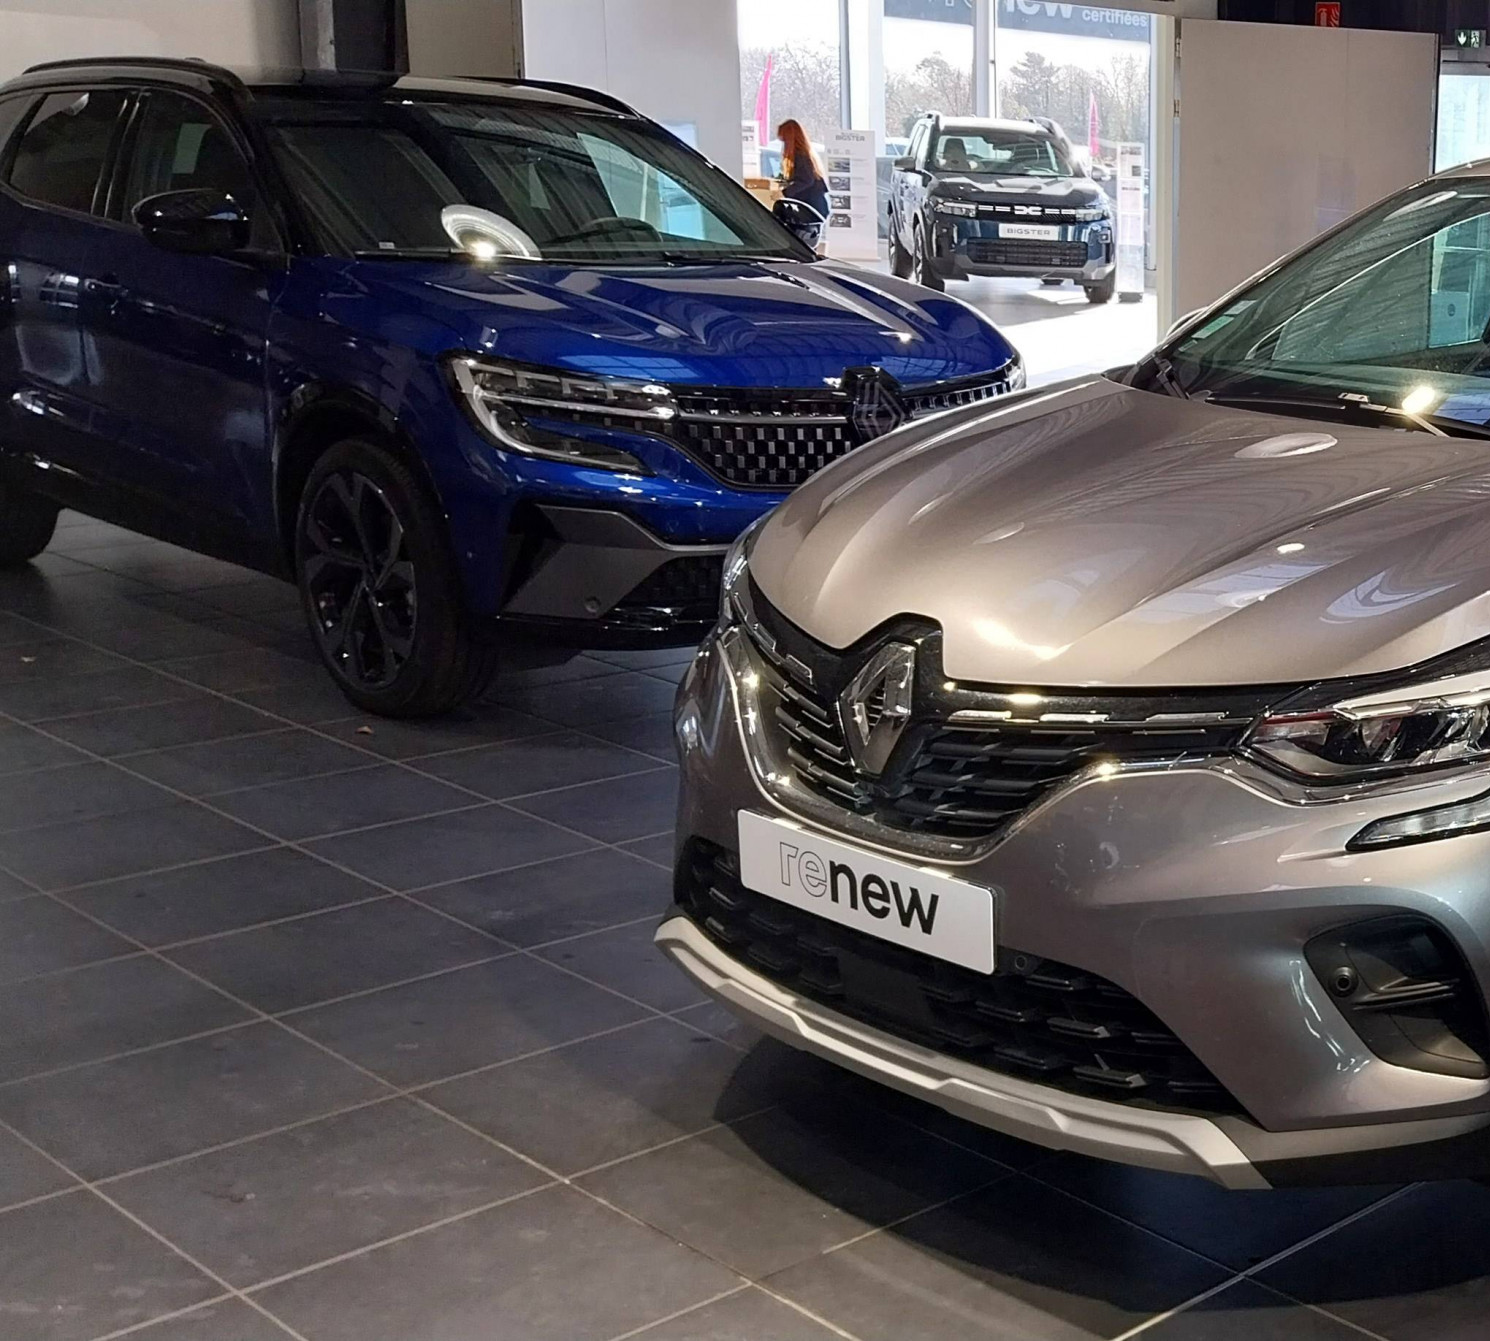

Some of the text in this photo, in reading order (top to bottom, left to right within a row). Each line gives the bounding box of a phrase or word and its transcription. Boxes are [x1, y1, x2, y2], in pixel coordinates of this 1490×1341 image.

[1081, 9, 1148, 27] certifiées
[1006, 227, 1051, 236] BIGSTER
[779, 841, 940, 936] renew
